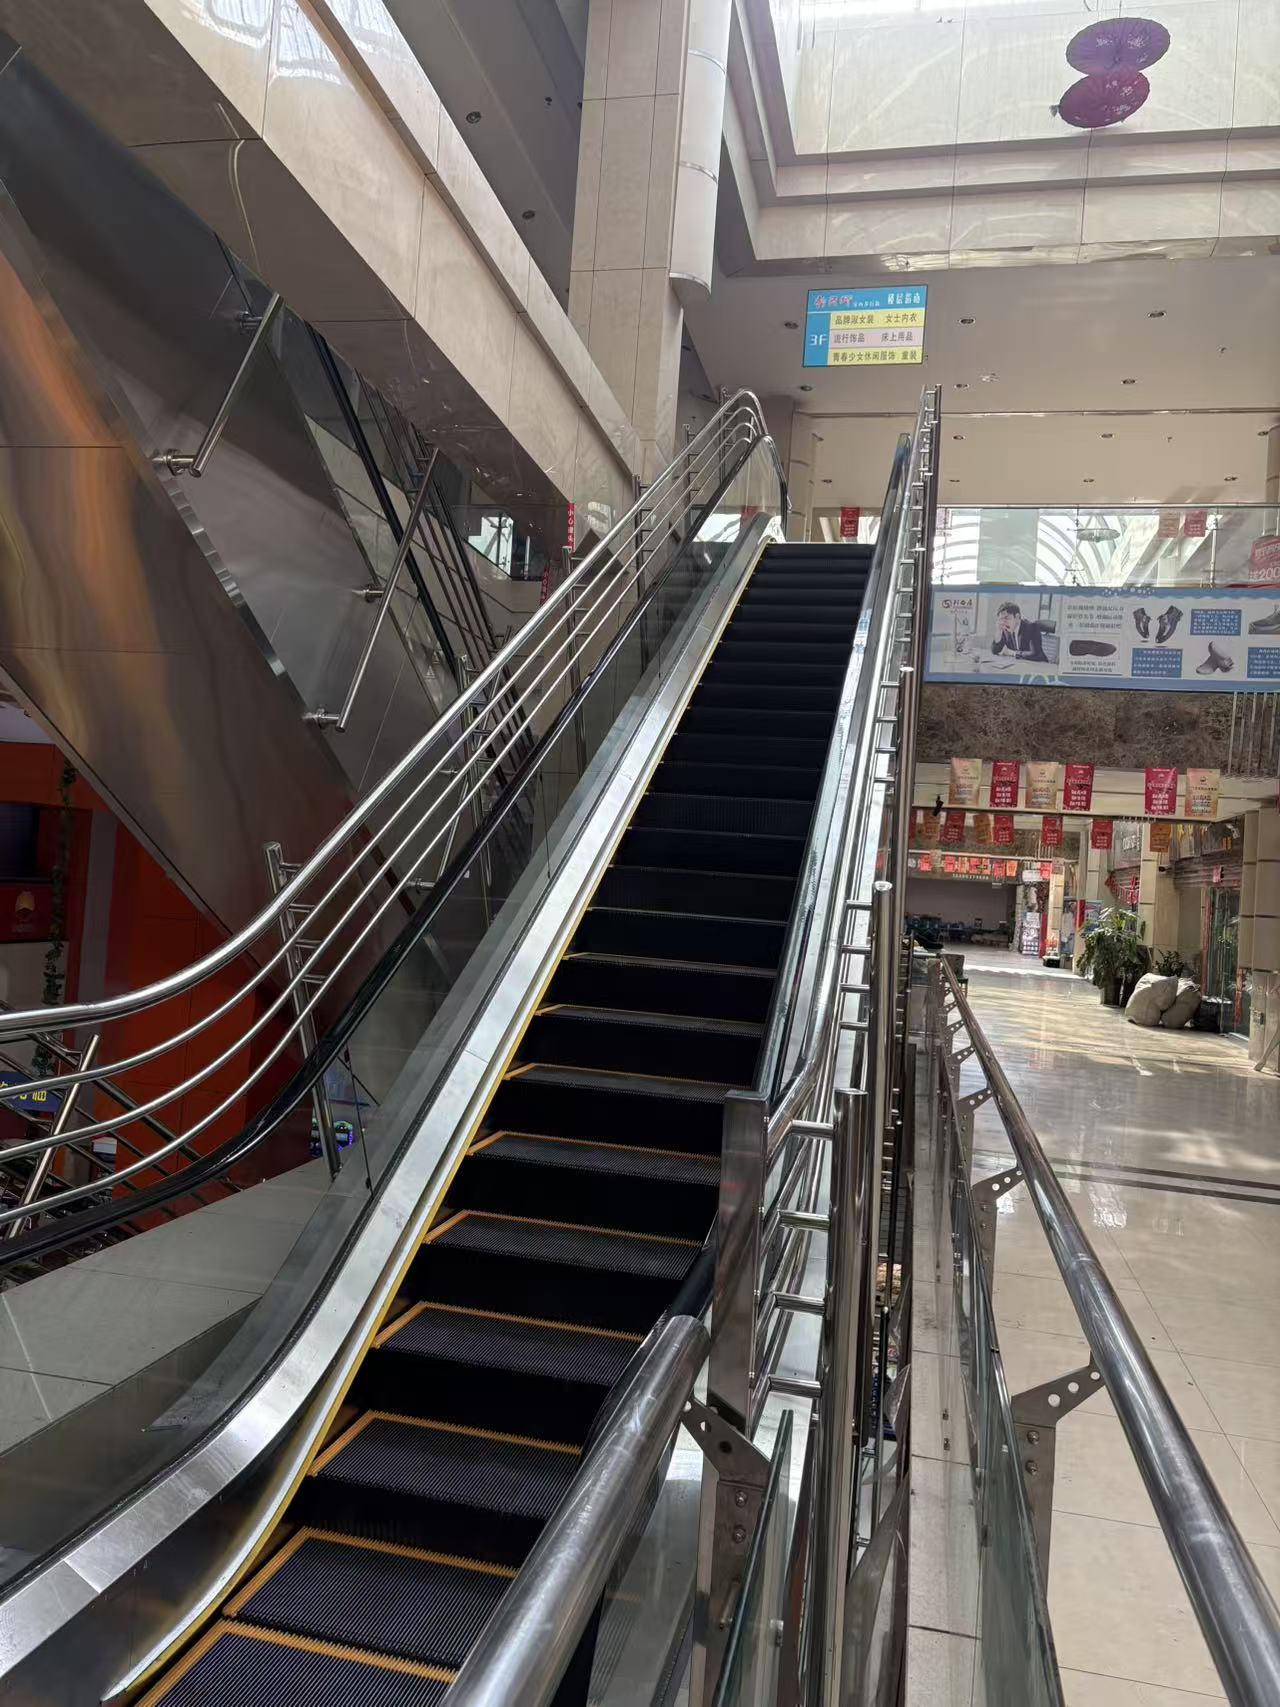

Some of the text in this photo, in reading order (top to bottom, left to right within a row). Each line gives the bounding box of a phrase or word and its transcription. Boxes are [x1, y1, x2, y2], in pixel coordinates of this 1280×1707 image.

[886, 313, 917, 324] 女士内衣
[810, 334, 827, 346] 3F
[834, 332, 913, 344] 流行饰品 床上用品
[833, 351, 917, 362] 青春少女休闲服饰 童装
